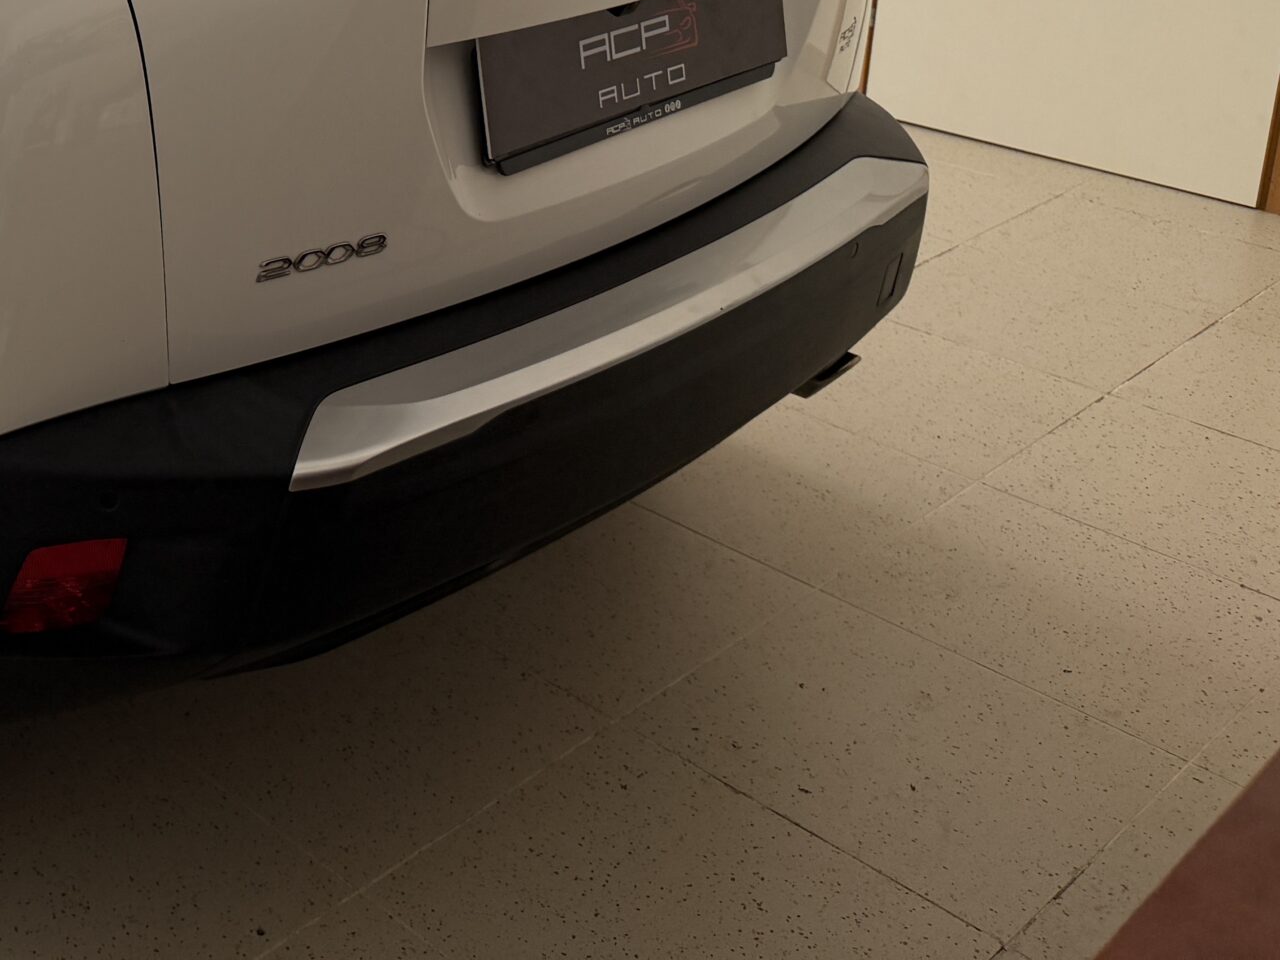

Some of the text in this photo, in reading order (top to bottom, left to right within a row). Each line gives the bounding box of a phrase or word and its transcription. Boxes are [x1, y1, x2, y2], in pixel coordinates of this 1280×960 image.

[579, 14, 670, 70] ACP
[598, 63, 686, 109] AUTO
[632, 109, 662, 125] AUTO
[256, 232, 388, 283] 2008
